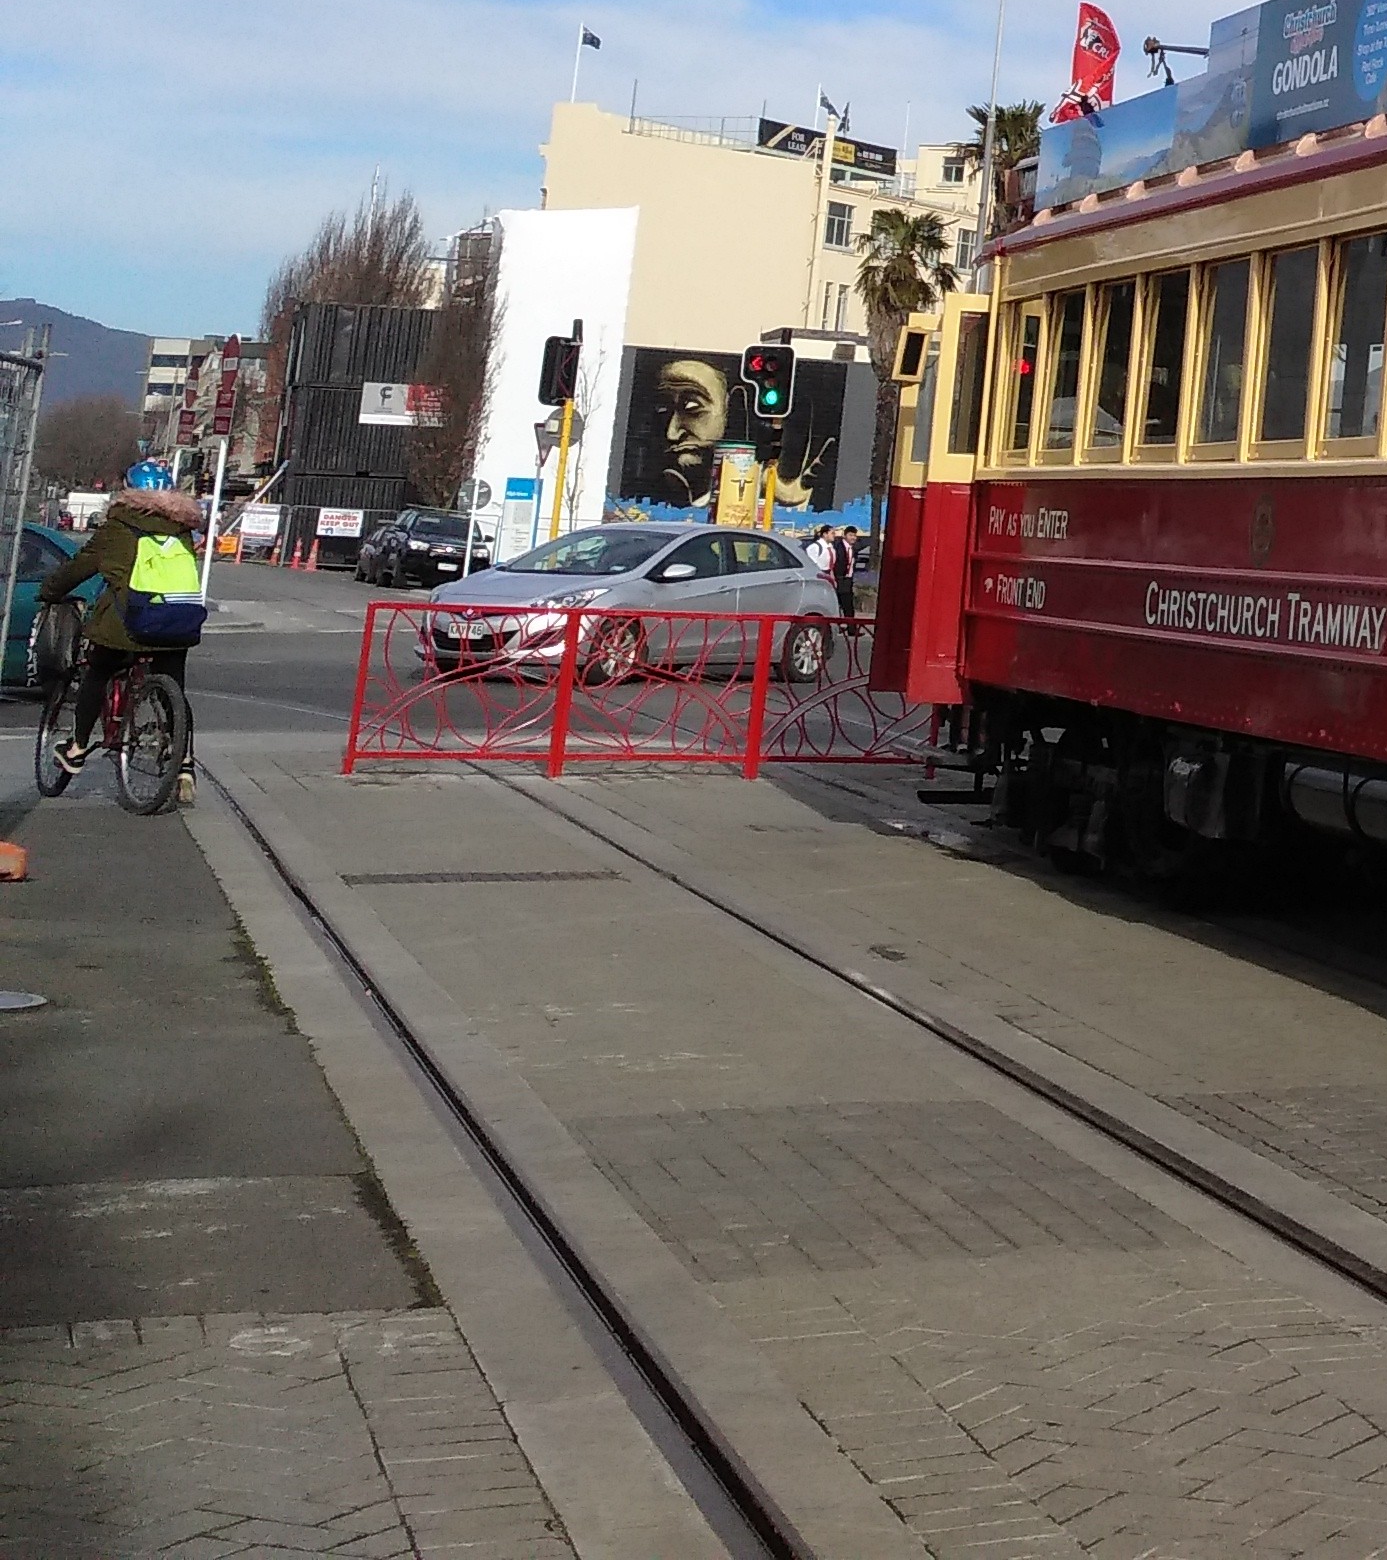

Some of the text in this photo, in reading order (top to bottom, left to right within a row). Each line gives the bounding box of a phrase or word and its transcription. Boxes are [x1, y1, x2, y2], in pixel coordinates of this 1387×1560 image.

[1272, 45, 1339, 96] GONDOLA
[791, 131, 805, 142] FOR
[320, 520, 360, 529] KEEP OUT
[323, 514, 358, 522] DANGER
[988, 506, 1068, 540] PAY AS YOU ENTER
[996, 574, 1046, 609] FRONT END
[1145, 581, 1387, 650] CHRISTCHURCH TRAMWAY
